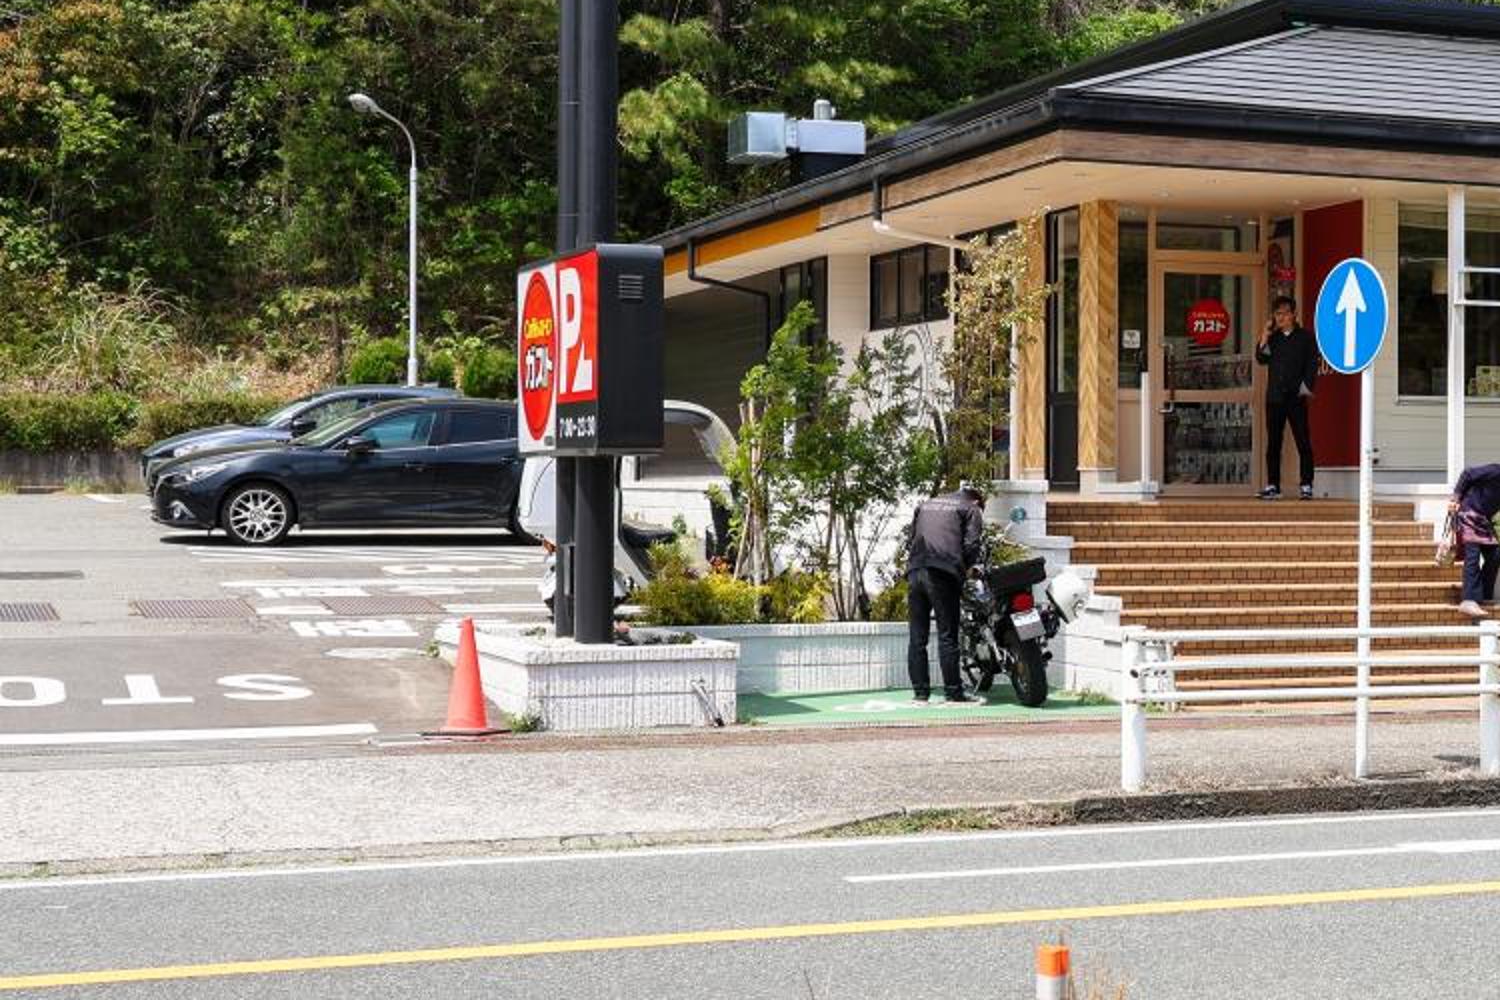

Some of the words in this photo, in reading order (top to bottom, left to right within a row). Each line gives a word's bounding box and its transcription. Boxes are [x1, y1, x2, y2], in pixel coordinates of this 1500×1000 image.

[559, 267, 583, 395] P
[1193, 319, 1226, 333] ガスト
[526, 345, 553, 389] ガスト
